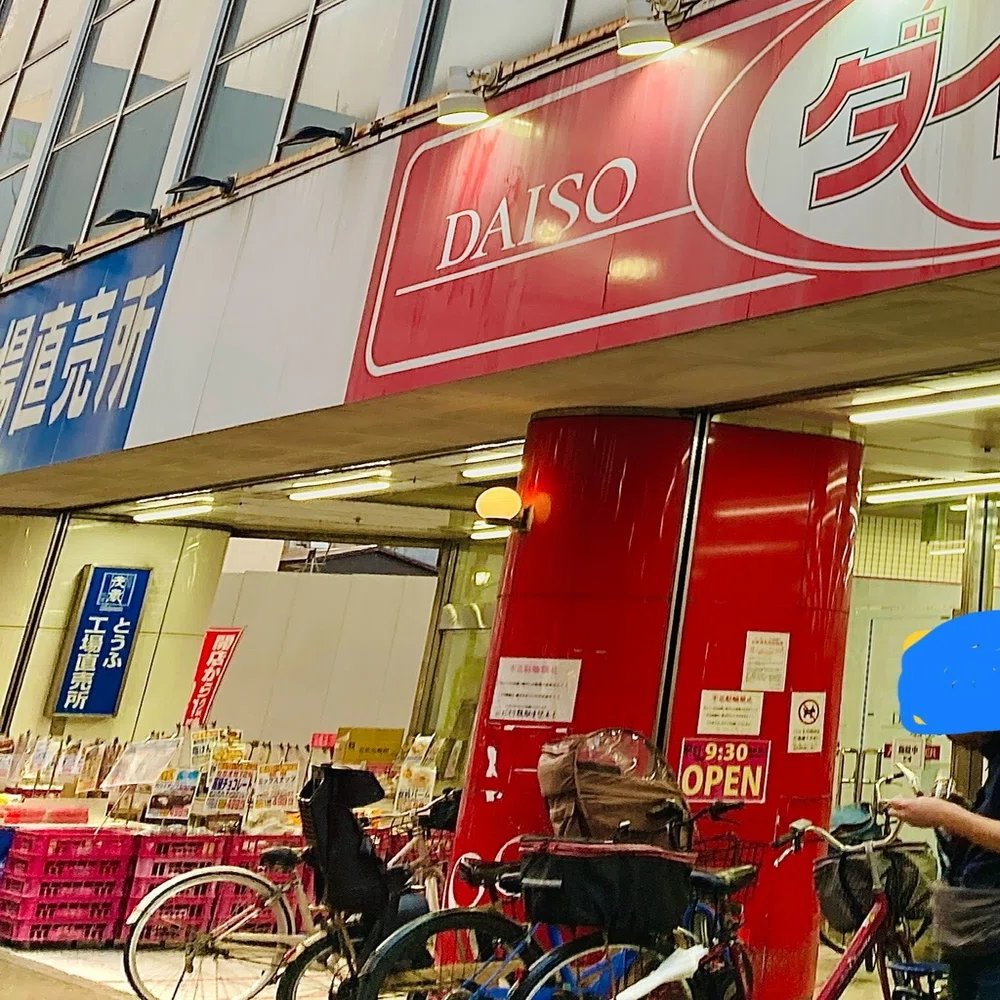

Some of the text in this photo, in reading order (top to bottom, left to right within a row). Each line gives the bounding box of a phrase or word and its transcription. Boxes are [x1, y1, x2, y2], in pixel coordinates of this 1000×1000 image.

[435, 156, 638, 271] DAISO
[63, 615, 109, 711] 工場直売所
[102, 616, 131, 669] とうふ
[704, 741, 749, 762] 9:30
[681, 763, 763, 797] OPEN
